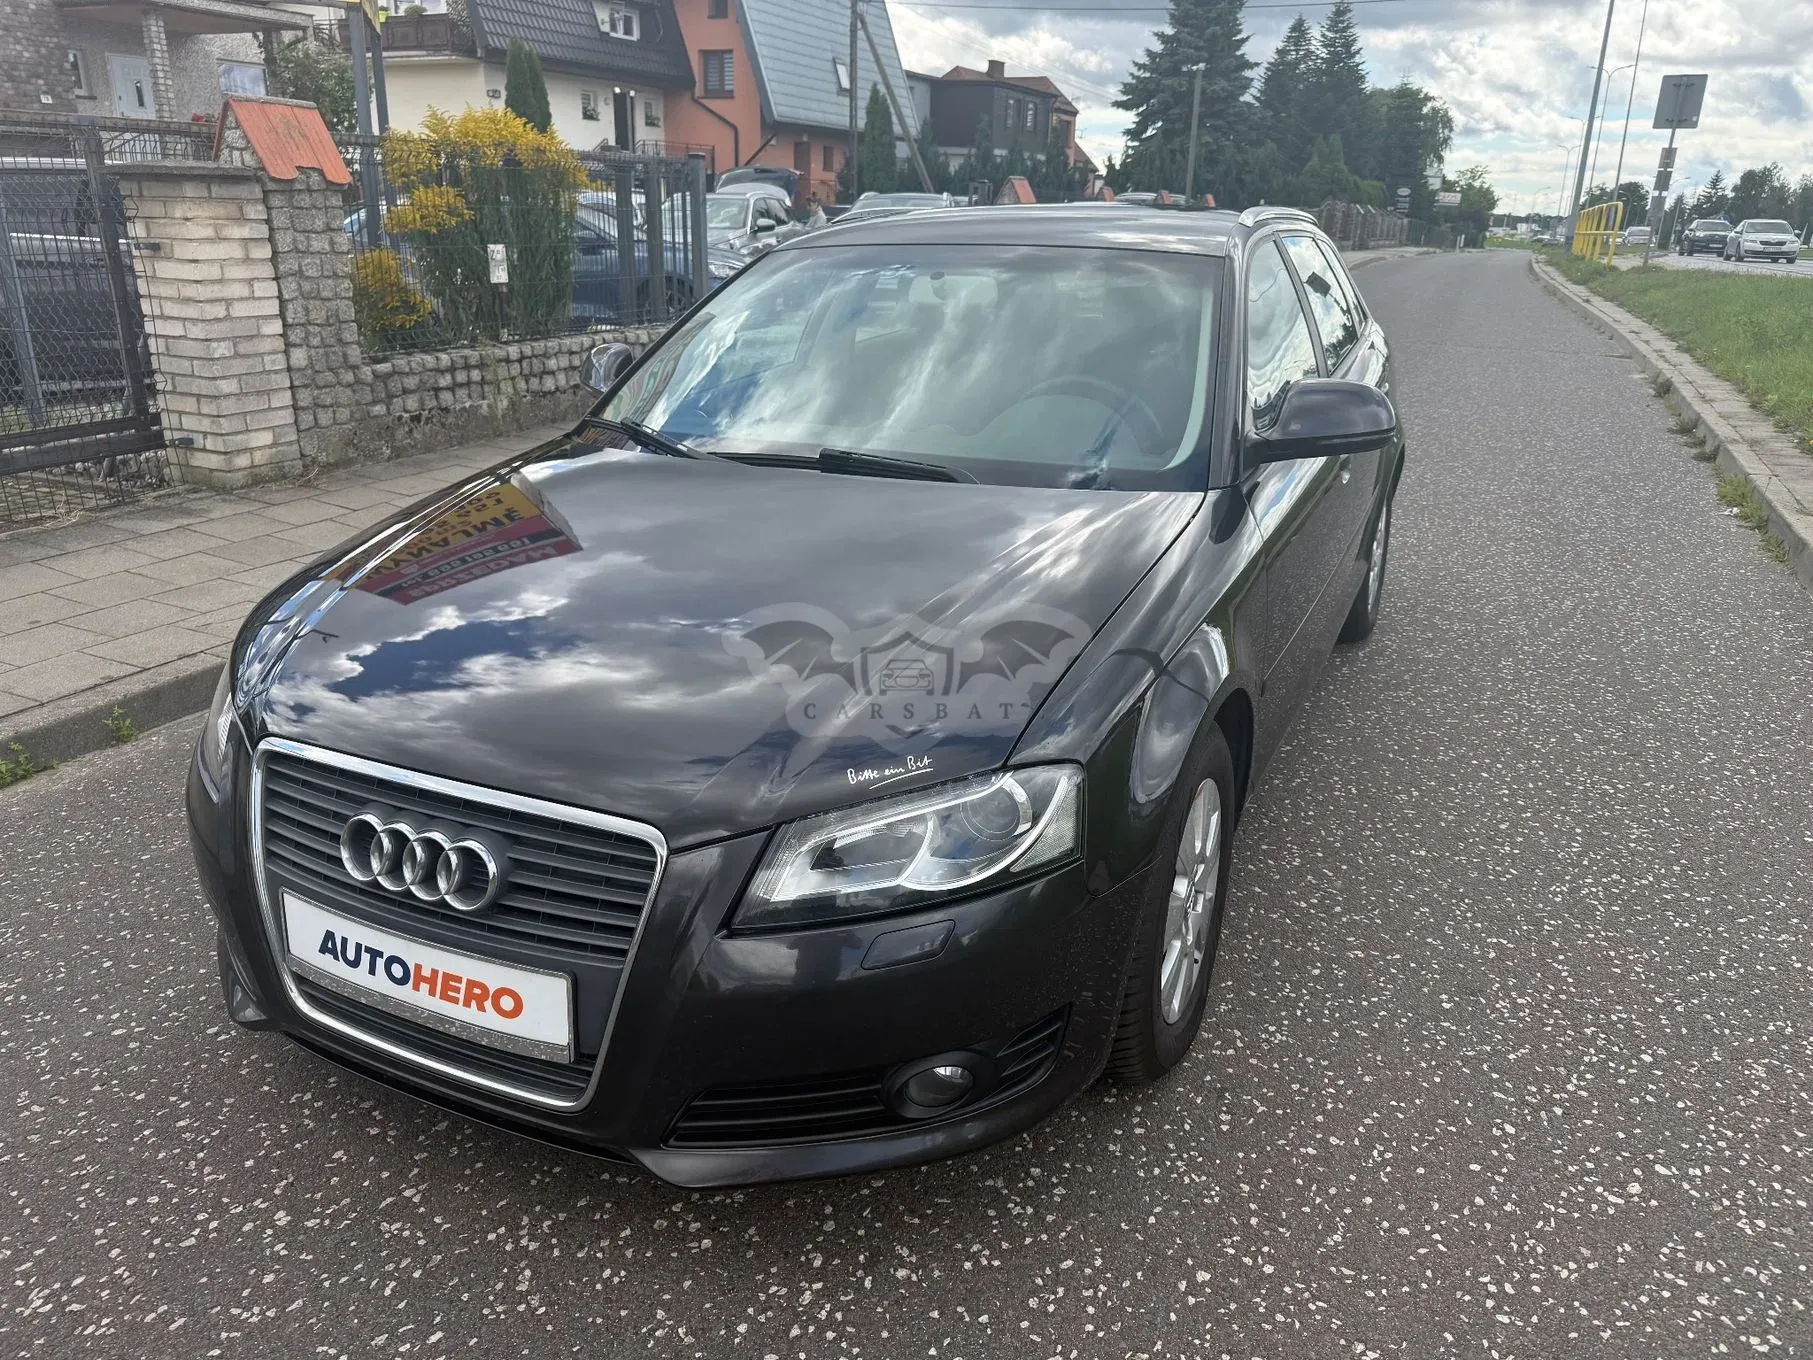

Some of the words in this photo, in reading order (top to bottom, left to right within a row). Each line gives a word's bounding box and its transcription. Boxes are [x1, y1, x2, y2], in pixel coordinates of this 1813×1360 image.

[847, 768, 879, 784] Bitte
[884, 765, 905, 775] ein
[907, 755, 933, 770] Bit
[318, 928, 524, 1020] AUTOHERO
